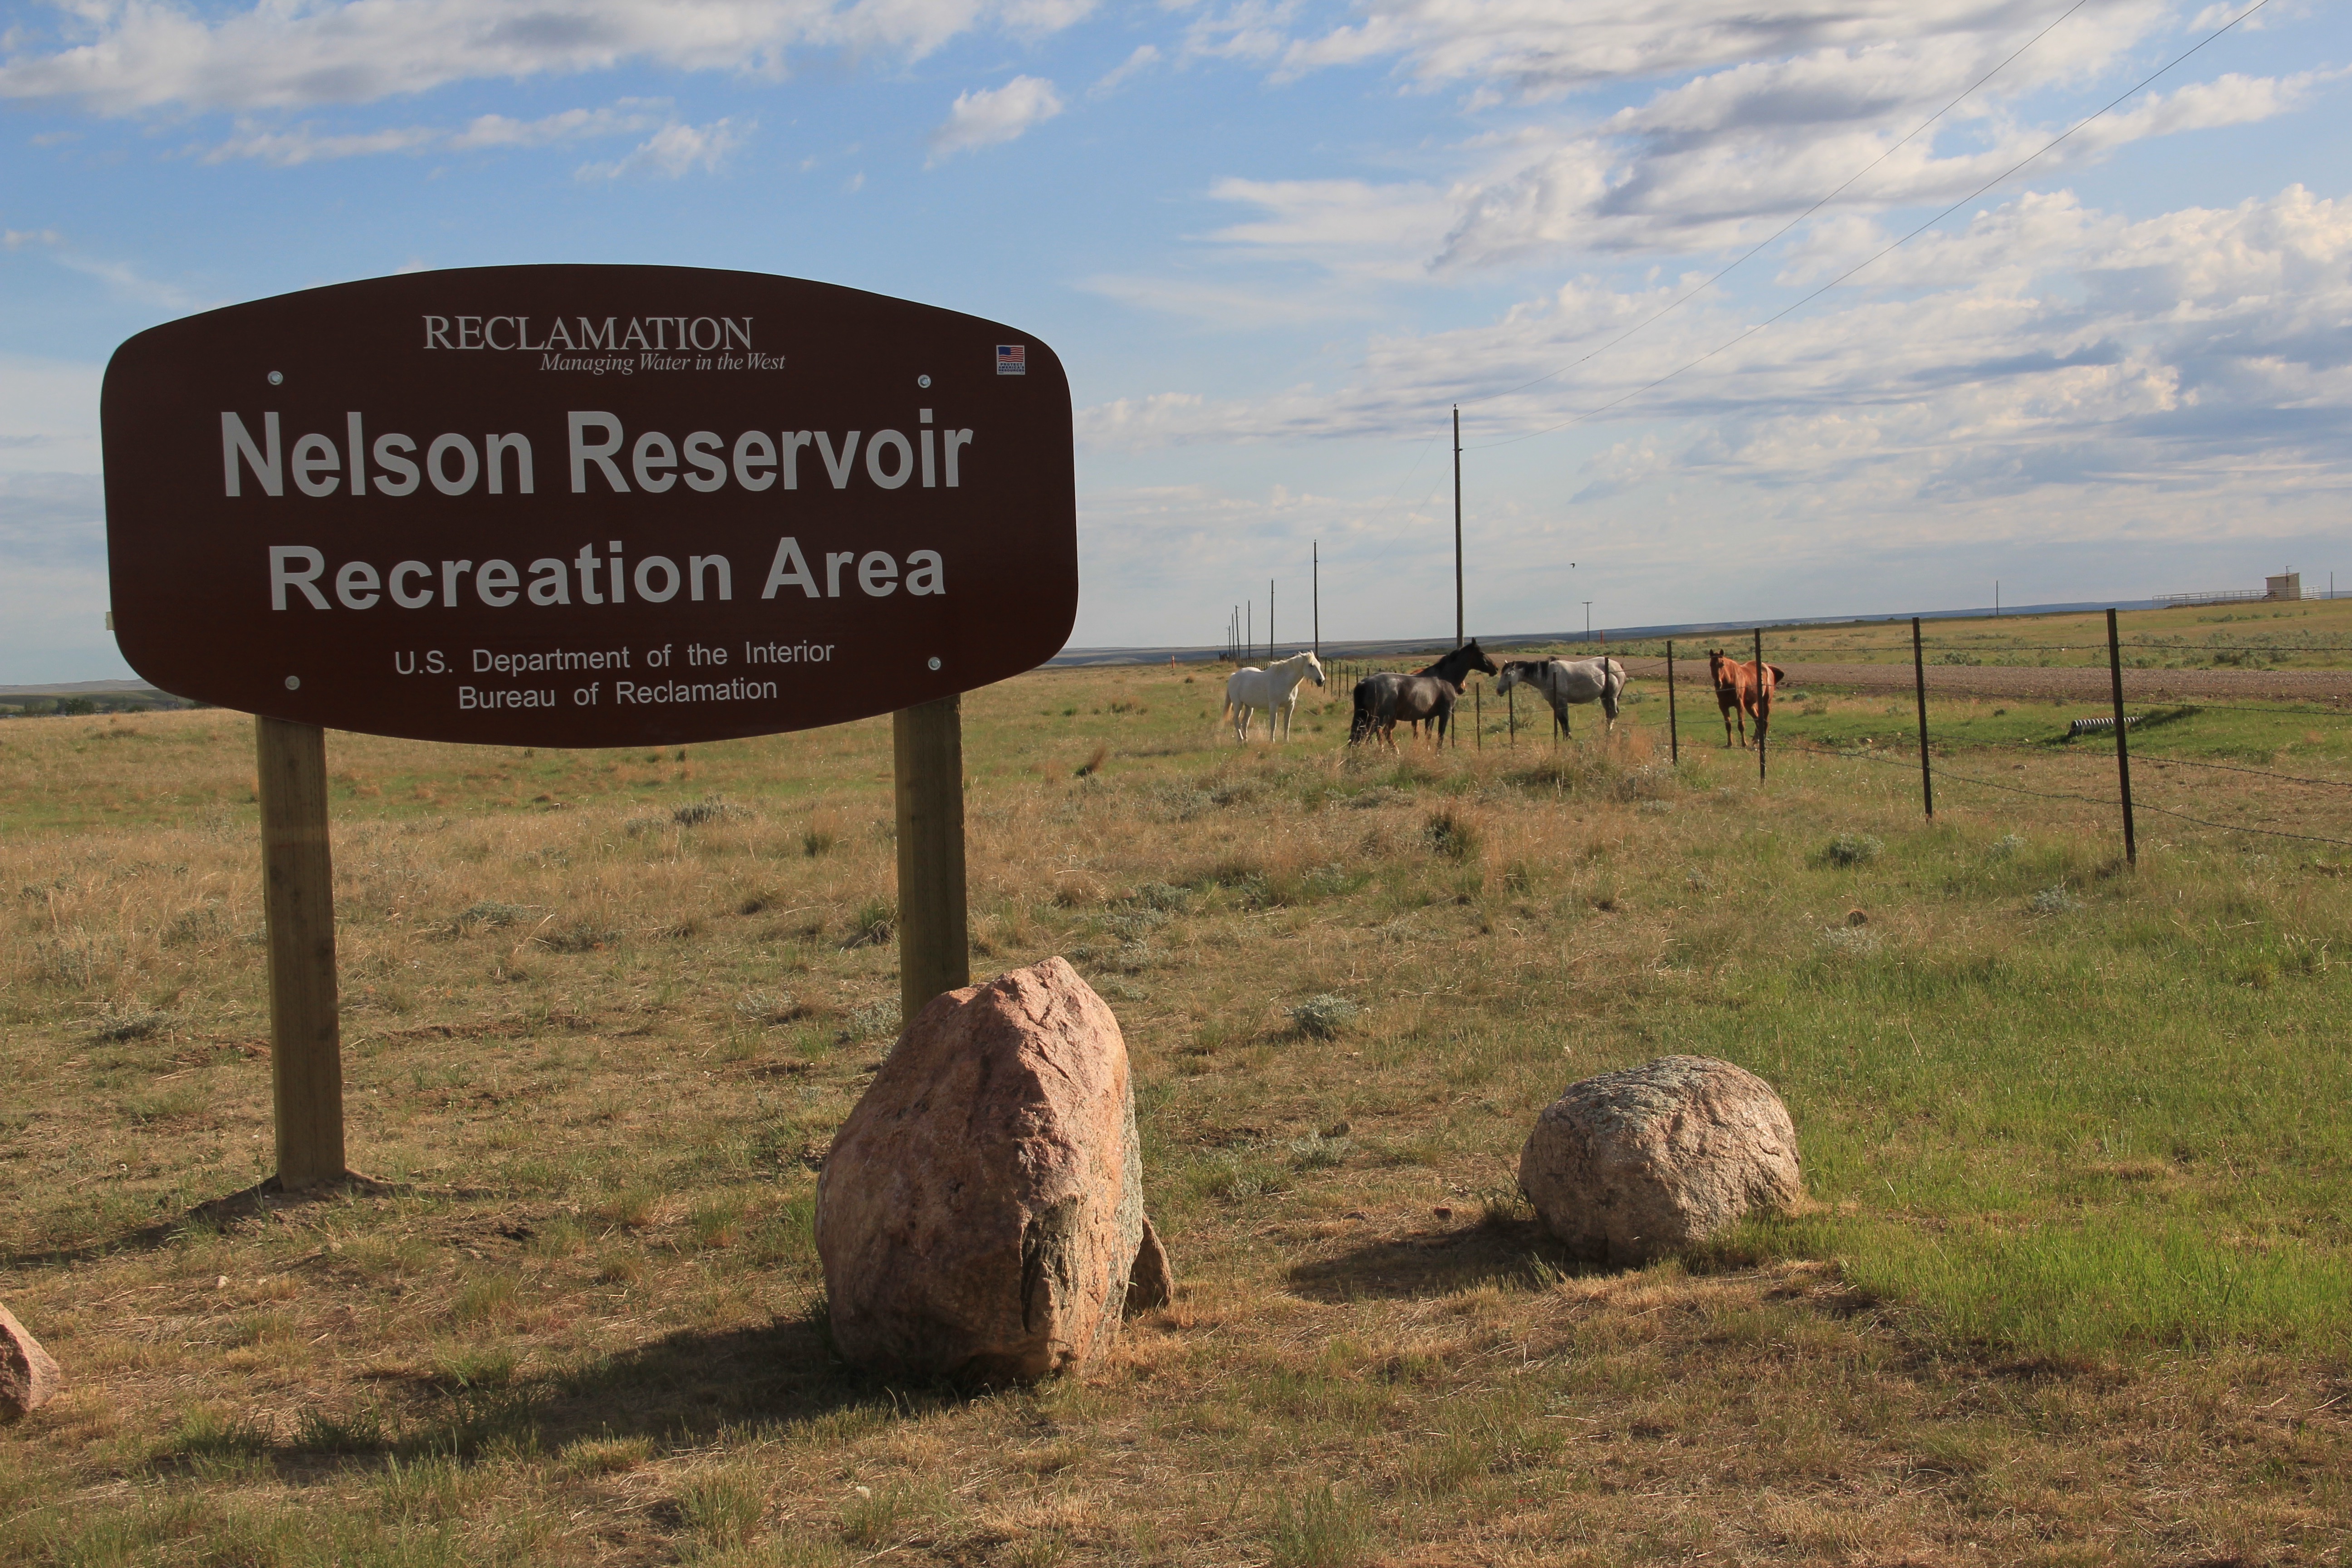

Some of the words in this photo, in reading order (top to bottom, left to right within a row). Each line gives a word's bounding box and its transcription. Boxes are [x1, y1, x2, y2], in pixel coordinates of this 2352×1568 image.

[422, 316, 754, 350] RECLAMATION
[539, 353, 634, 375] Managing
[640, 353, 691, 370] Water
[696, 353, 711, 370] in
[717, 353, 743, 370] the
[747, 353, 786, 369] West
[221, 412, 534, 497] Nelson
[568, 408, 974, 493] Reservoir
[269, 540, 732, 610] Recreation
[761, 537, 946, 599] Area
[395, 650, 452, 675] U.S.
[473, 646, 631, 677] Department
[647, 644, 672, 667] of
[687, 643, 727, 666] the
[745, 640, 835, 665] Interior
[459, 684, 555, 709] Bureau
[574, 682, 599, 706] of
[616, 677, 777, 704] Reclamation
